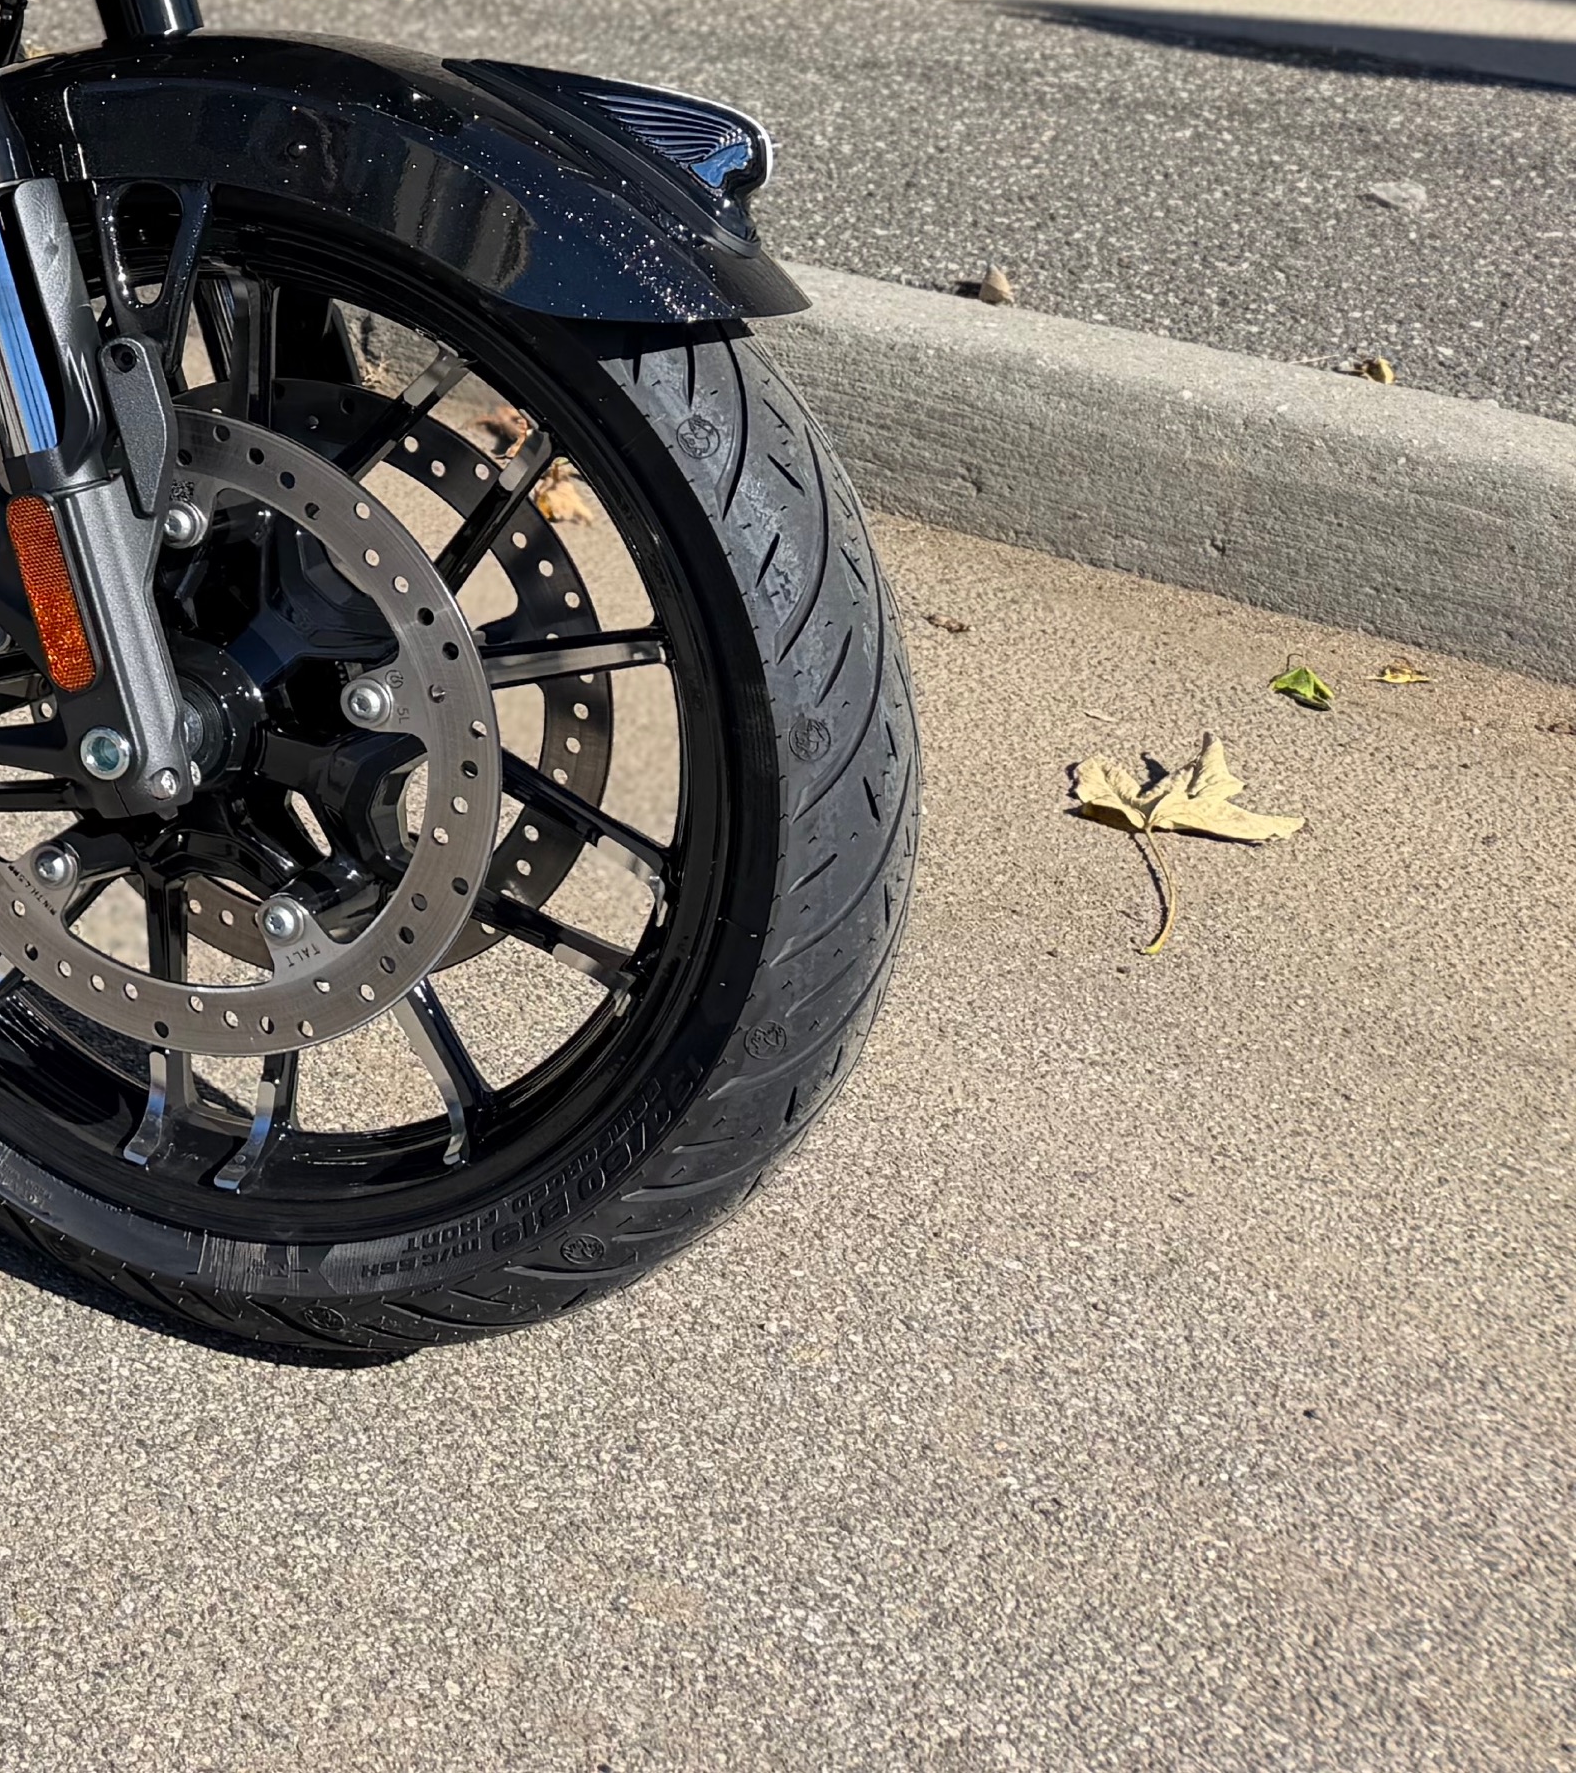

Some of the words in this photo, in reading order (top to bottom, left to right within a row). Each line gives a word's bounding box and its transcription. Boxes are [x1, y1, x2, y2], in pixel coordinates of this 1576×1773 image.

[285, 943, 321, 967] TALT
[401, 1209, 499, 1254] FRONT
[362, 1258, 417, 1279] 66H
